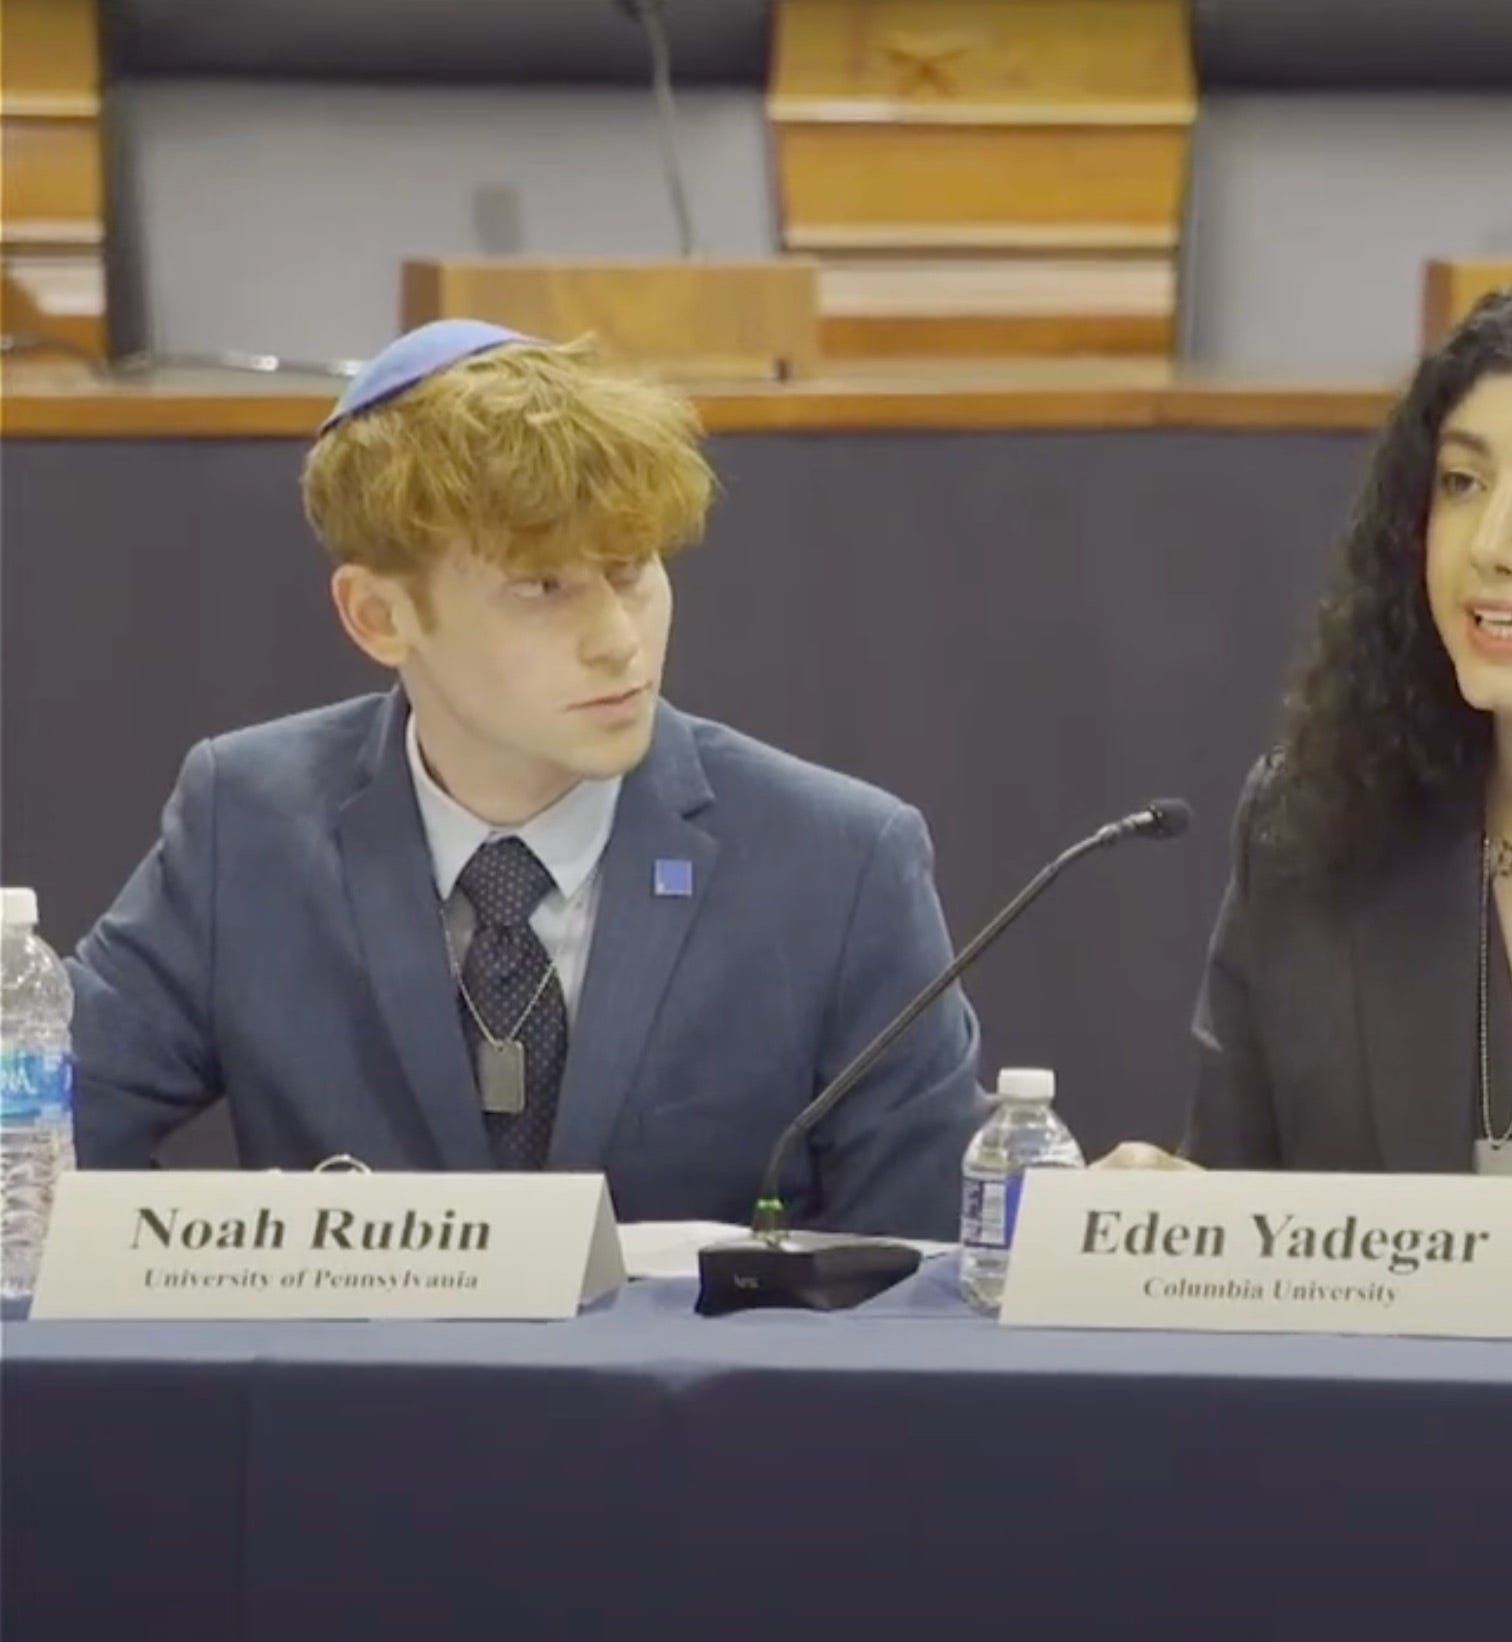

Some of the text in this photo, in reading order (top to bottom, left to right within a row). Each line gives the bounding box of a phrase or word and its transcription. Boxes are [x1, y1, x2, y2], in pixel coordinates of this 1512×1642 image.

[129, 1206, 491, 1251] Noah Rubin
[1080, 1209, 1490, 1274] Eden Yadegar
[143, 1268, 479, 1294] University of Pennsylvania
[1142, 1277, 1400, 1306] Columbia University
